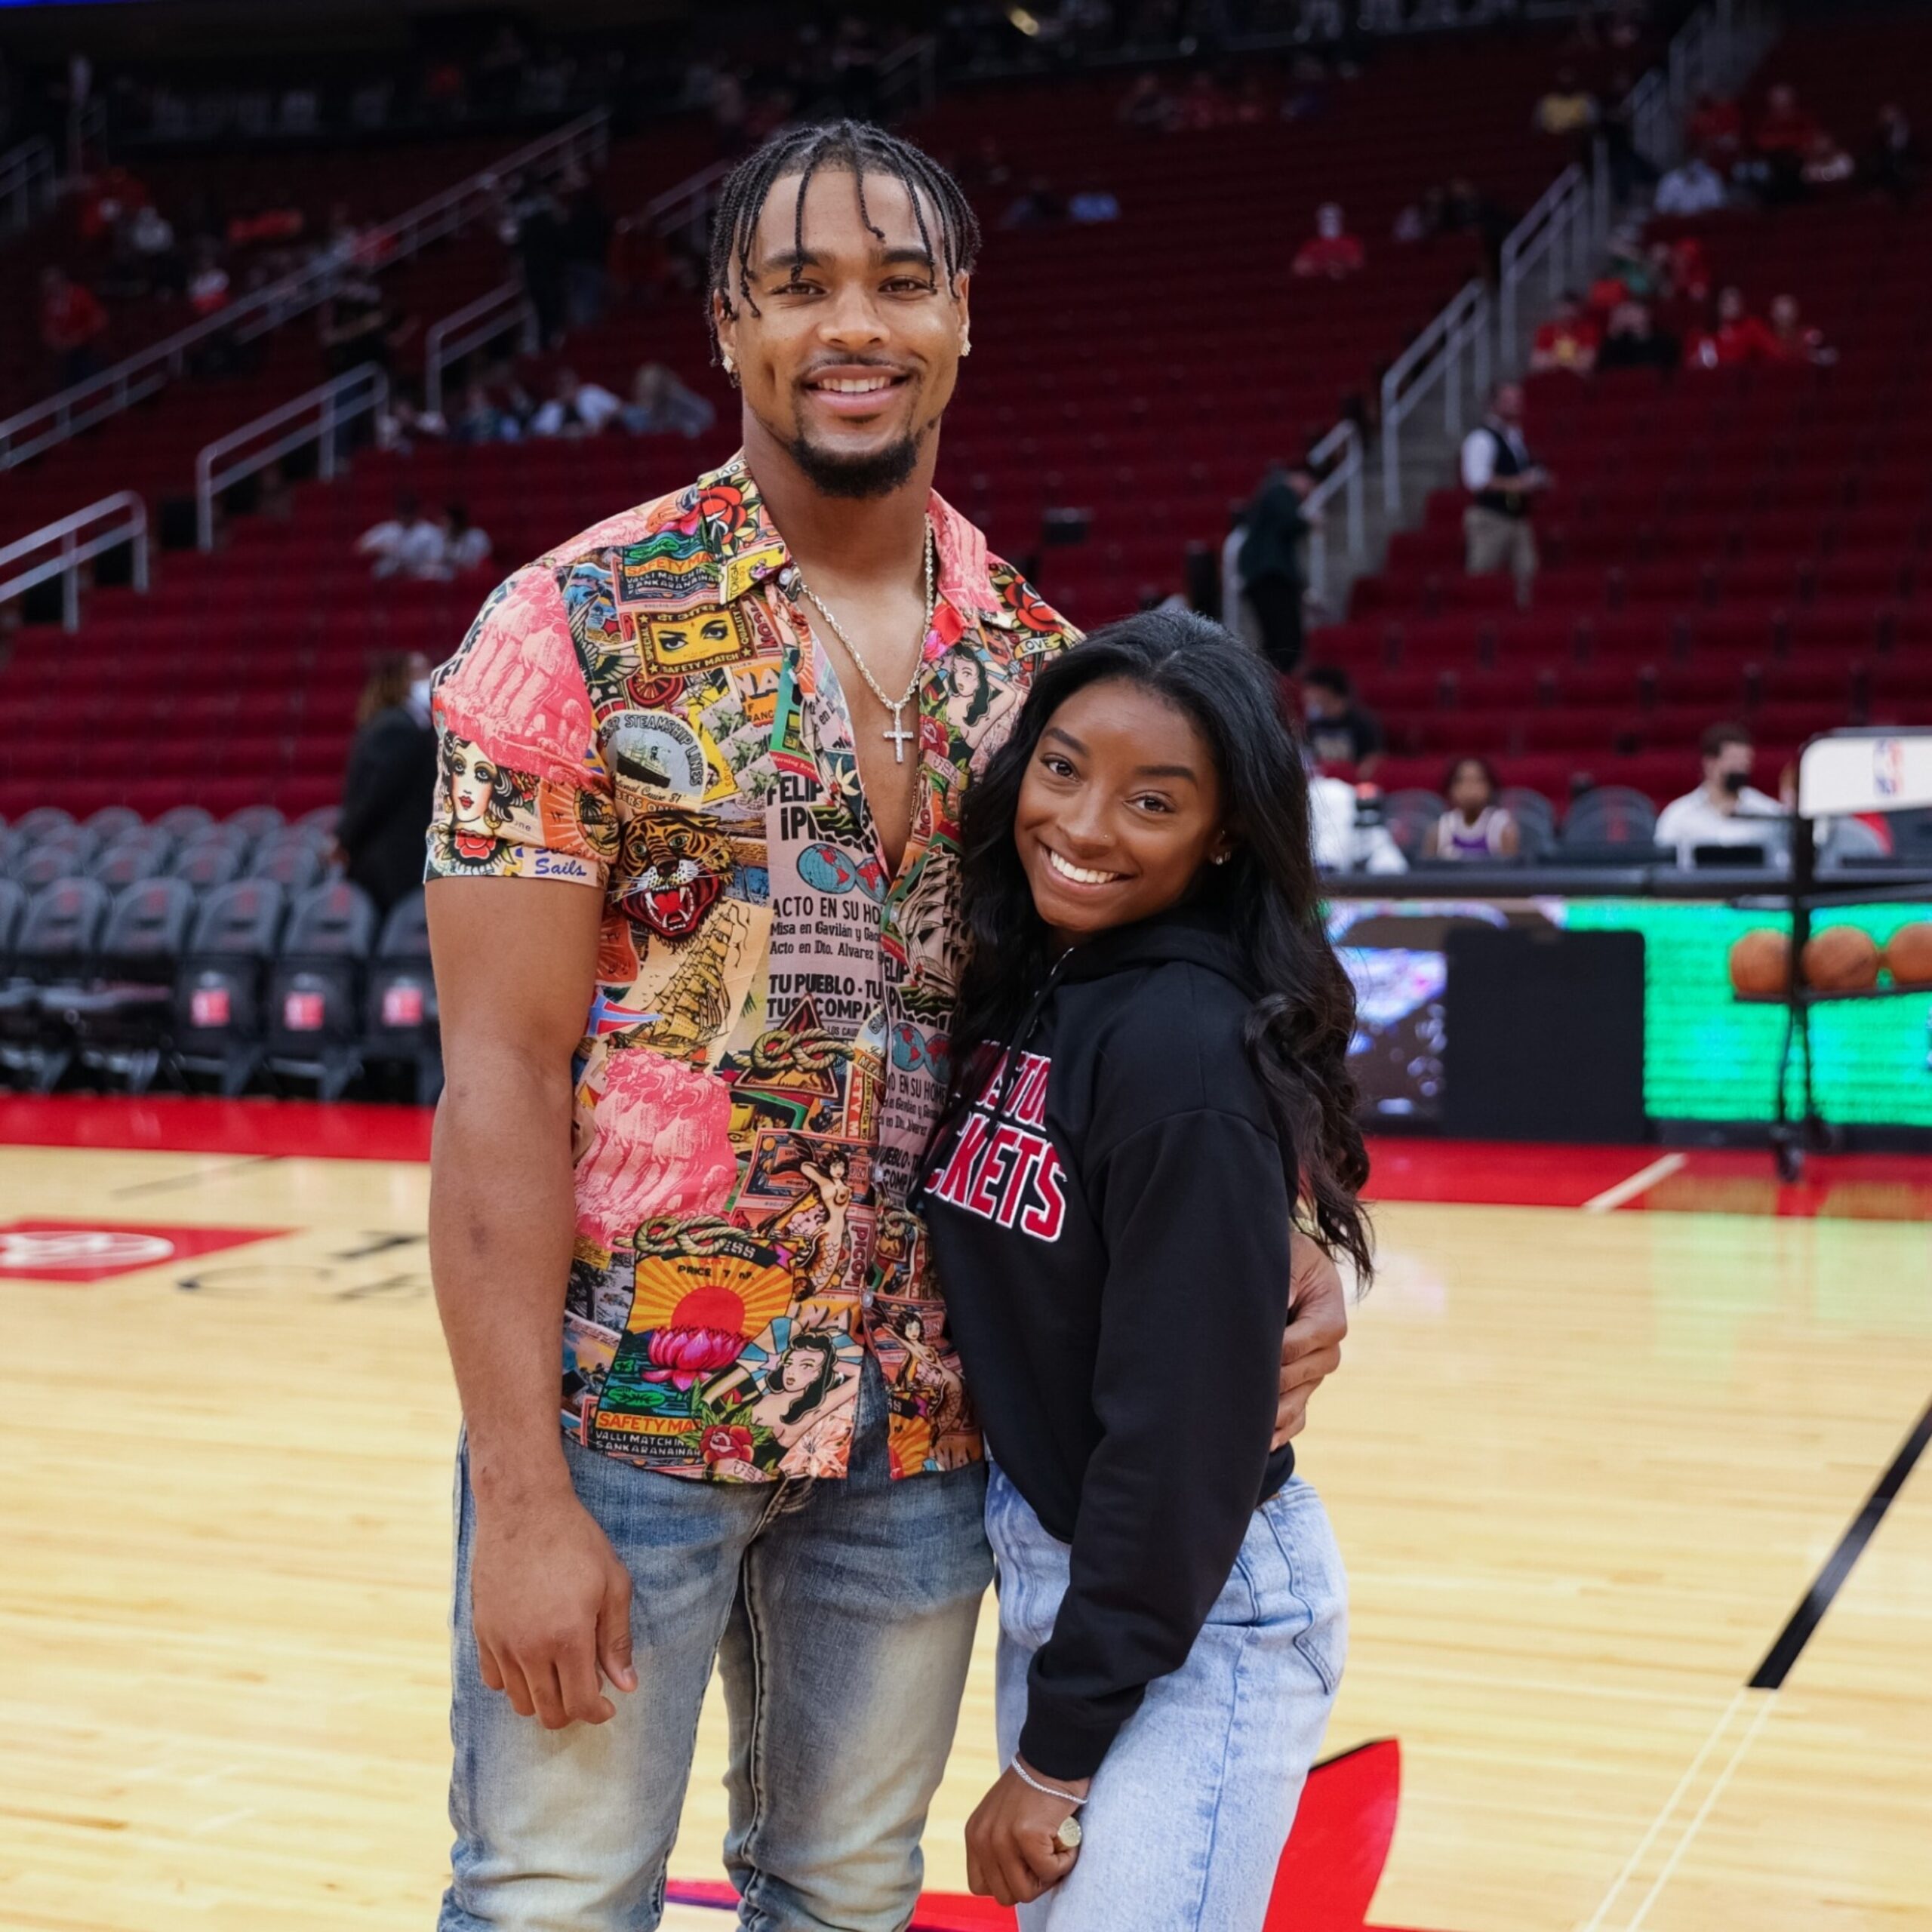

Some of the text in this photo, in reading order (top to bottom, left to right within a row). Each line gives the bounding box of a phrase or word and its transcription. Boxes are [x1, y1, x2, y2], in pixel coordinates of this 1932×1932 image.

[627, 553, 713, 573] SAFETY MA
[658, 571, 694, 582] MATCH
[730, 564, 739, 598] TONGA
[641, 626, 654, 660] SPECIAL
[1020, 637, 1052, 653] LOVE
[663, 662, 701, 673] SAFETY
[704, 653, 739, 666] MATCH
[625, 714, 703, 786] STEAMSHIP LINES
[534, 858, 587, 876] Sails
[773, 896, 881, 924] ACTO EN SU HO
[770, 921, 795, 936] Misa
[800, 923, 811, 935] en
[855, 928, 862, 942] y
[769, 941, 794, 955] Acto
[798, 943, 811, 954] en
[769, 974, 792, 994] TU
[795, 973, 855, 996] PUEBLO
[815, 998, 881, 1020] COMPA
[910, 1077, 921, 1098] SU
[678, 1265, 712, 1277] PRICE
[598, 1412, 665, 1432] SAFETY
[595, 1430, 626, 1441] VALLI
[629, 1435, 672, 1446] MATCH
